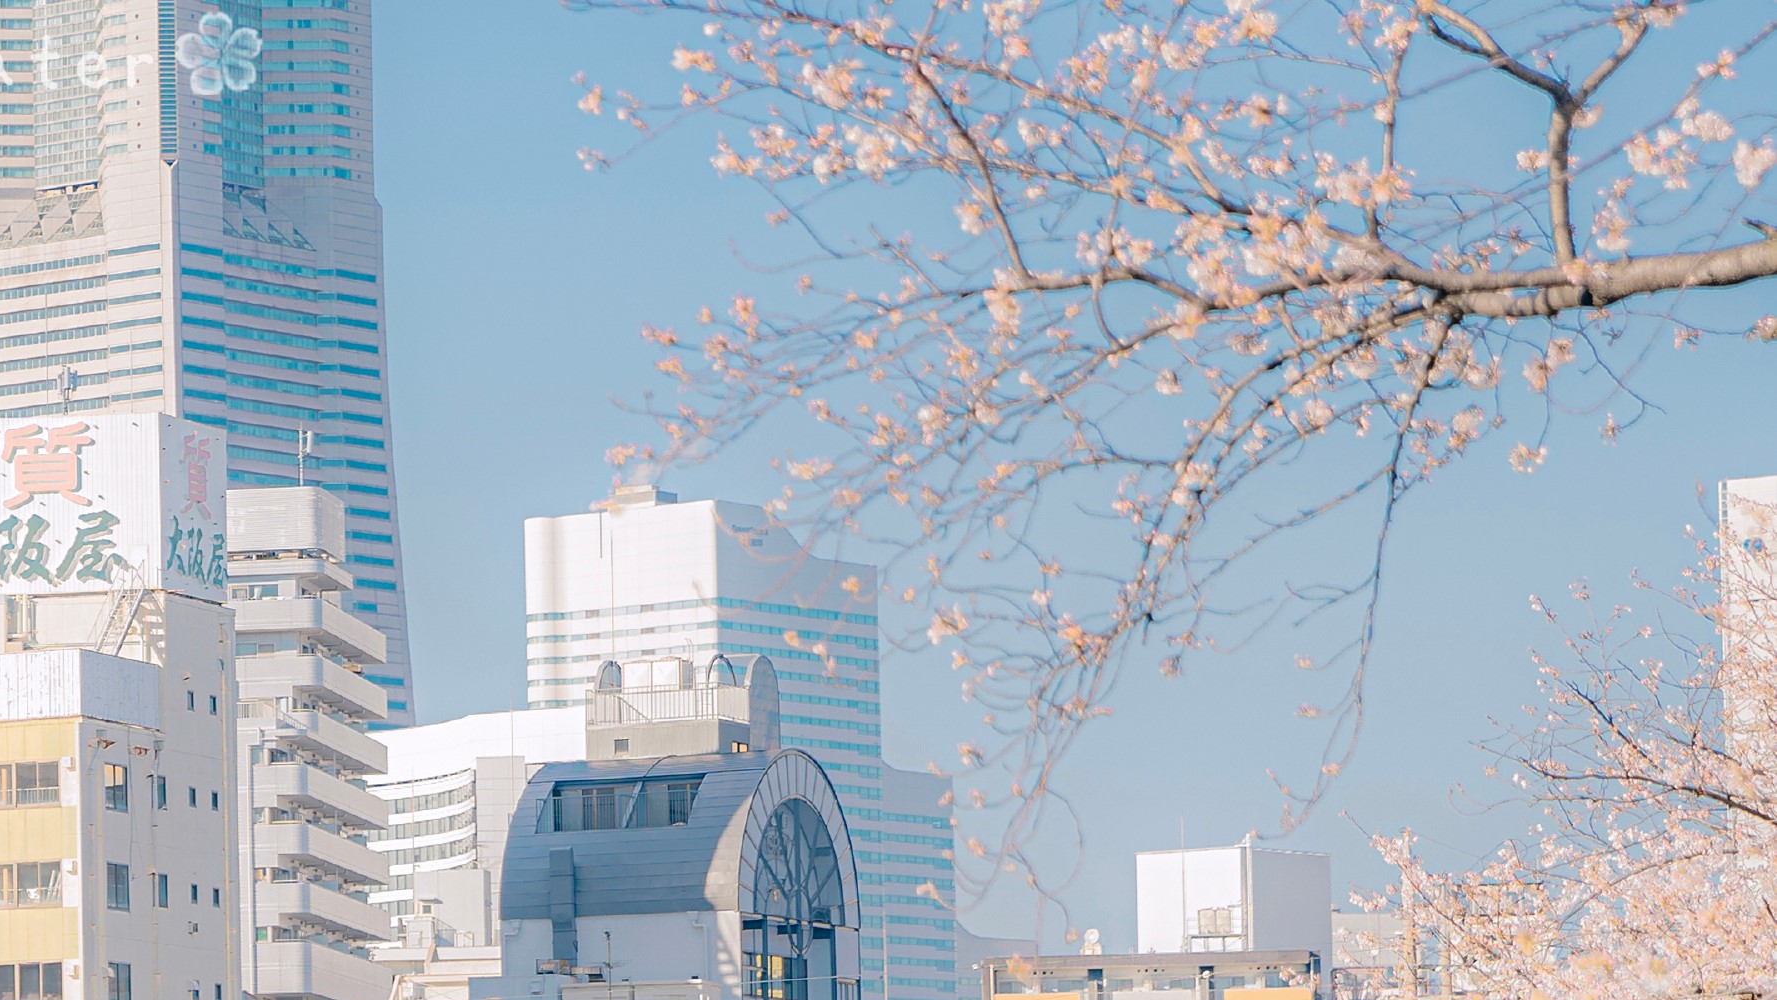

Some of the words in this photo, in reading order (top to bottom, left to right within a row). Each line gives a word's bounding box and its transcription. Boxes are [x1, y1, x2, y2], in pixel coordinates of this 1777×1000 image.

[0, 421, 96, 510] 質
[180, 430, 211, 521] 質
[166, 514, 229, 588] 大阪屋
